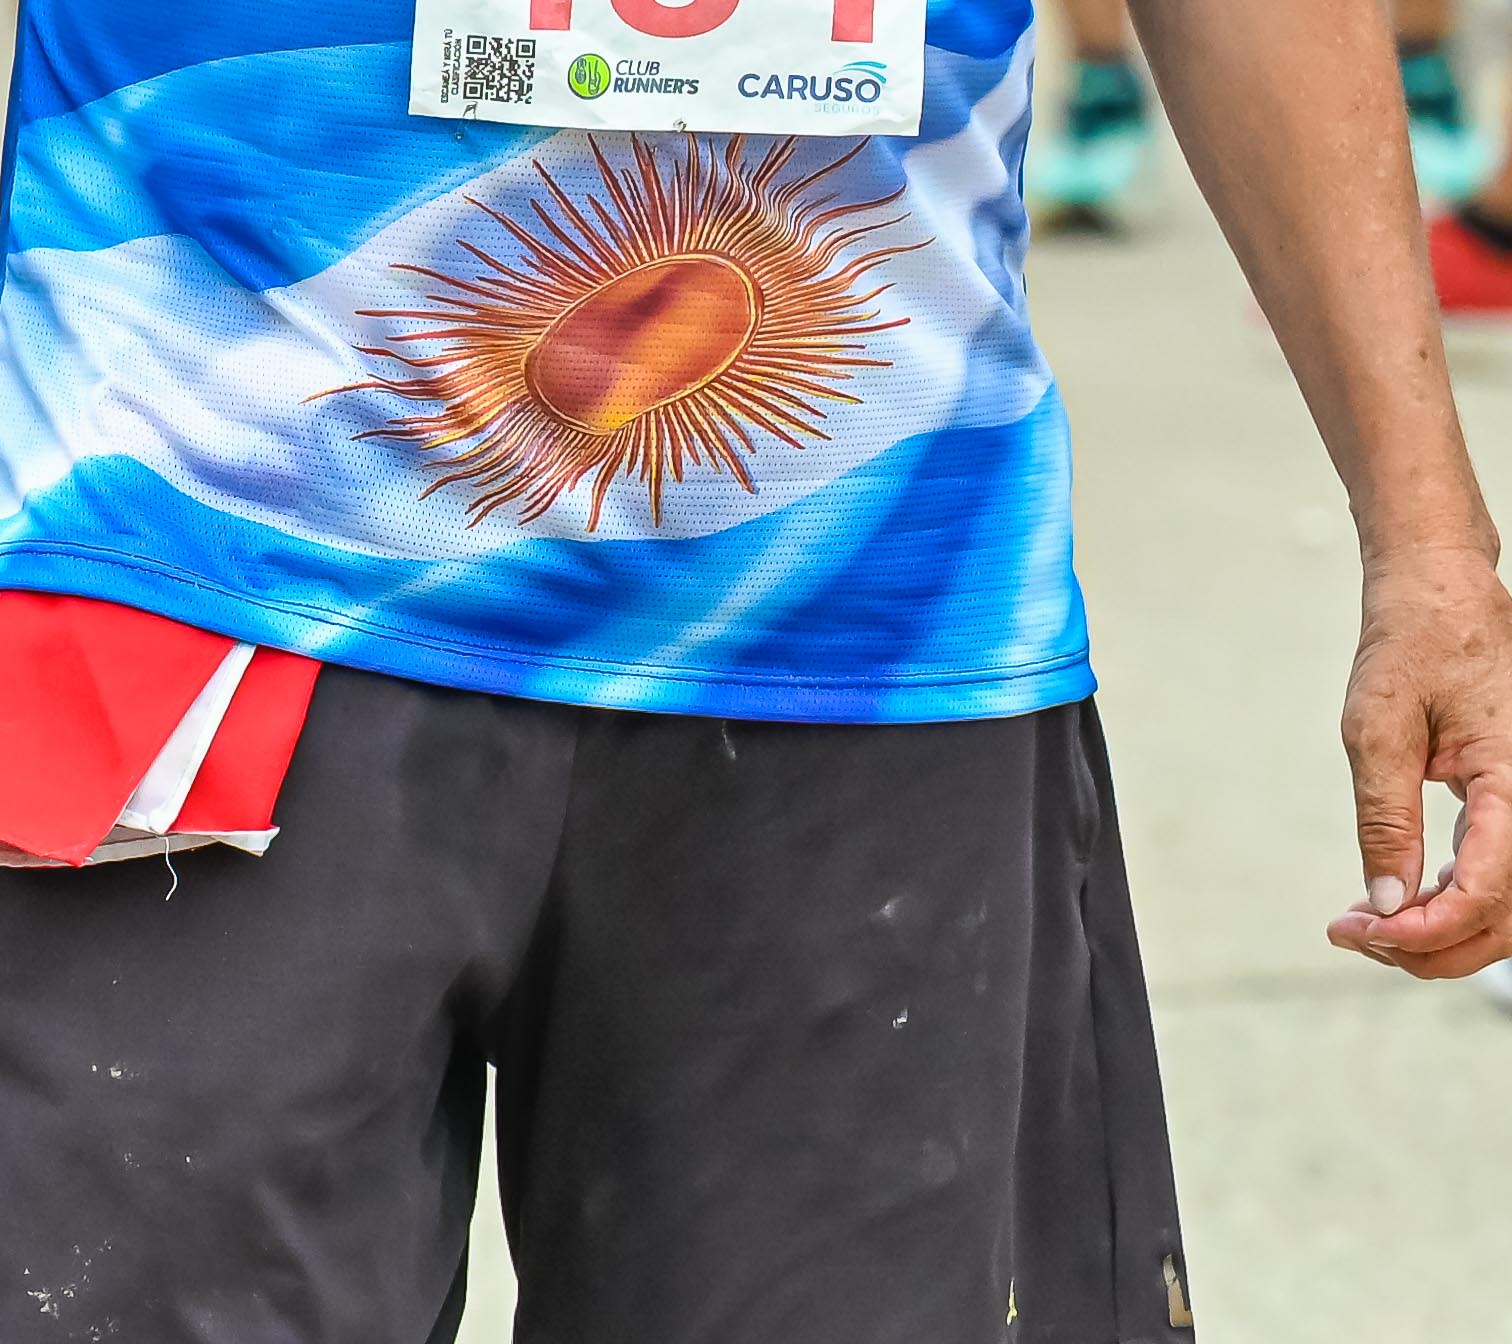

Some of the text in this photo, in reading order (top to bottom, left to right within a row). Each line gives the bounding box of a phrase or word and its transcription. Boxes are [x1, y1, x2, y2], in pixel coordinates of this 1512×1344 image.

[615, 60, 661, 76] CLUB
[613, 77, 699, 95] RUNNER'S
[738, 73, 882, 103] CARUSO
